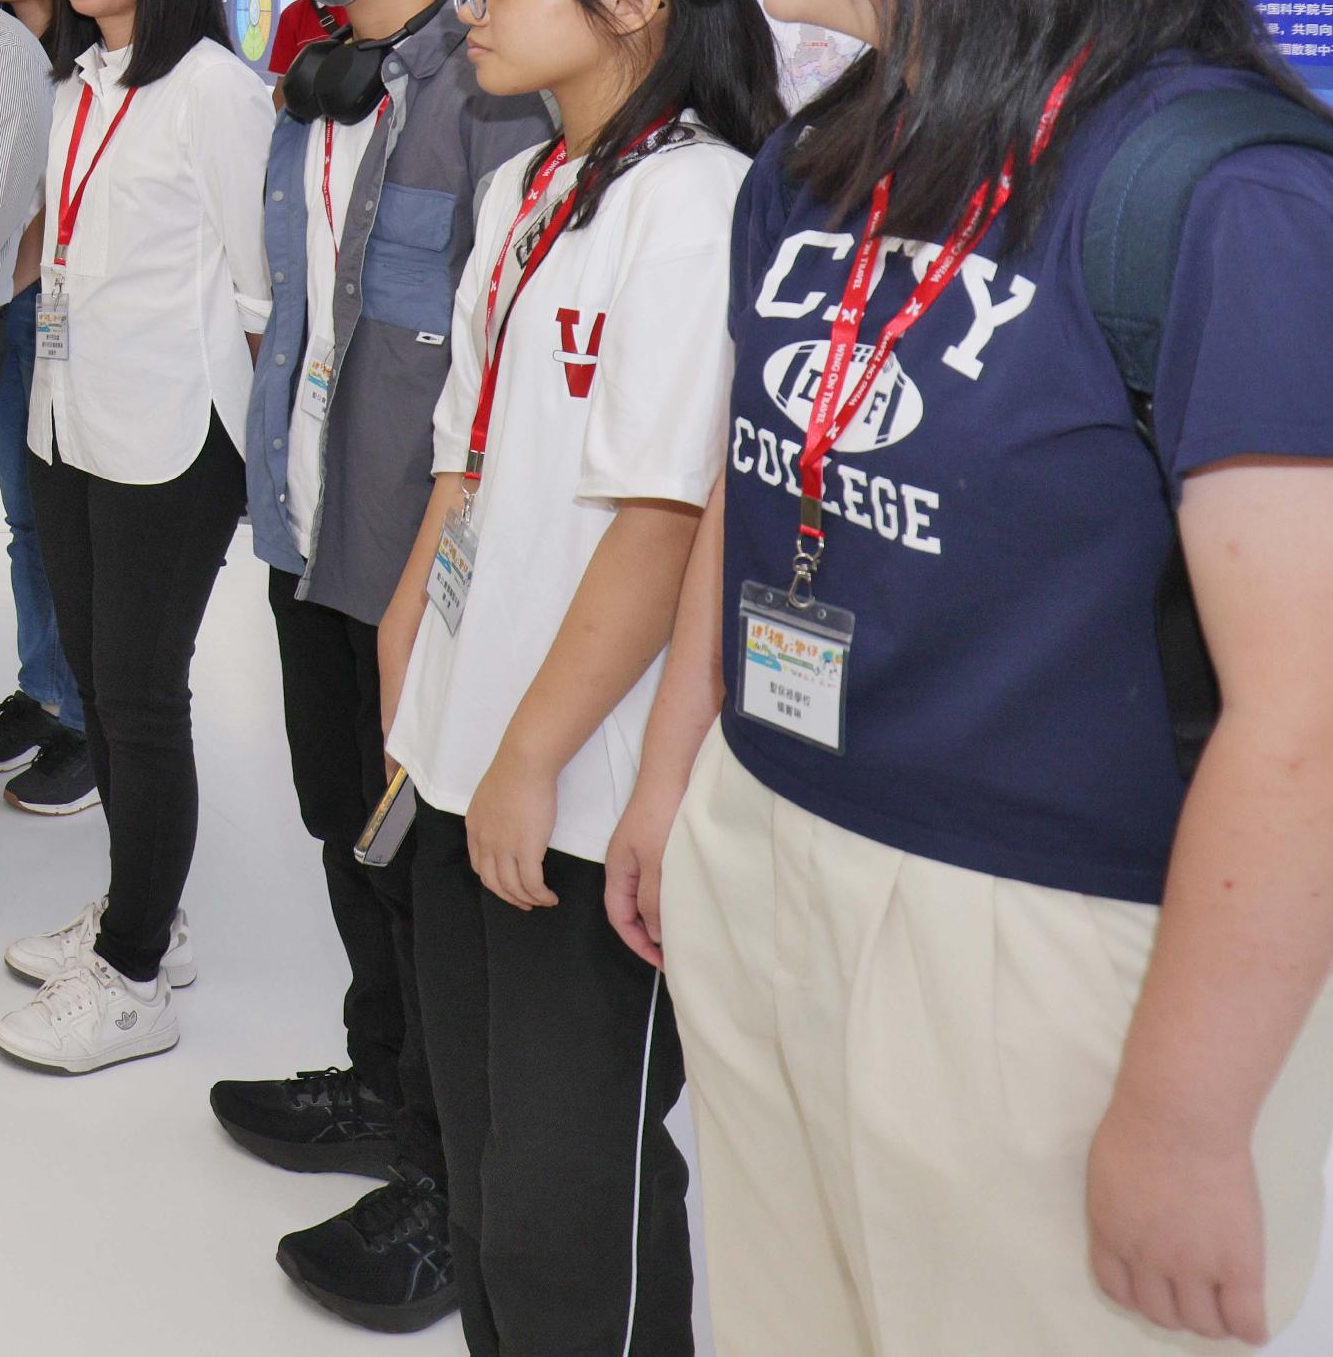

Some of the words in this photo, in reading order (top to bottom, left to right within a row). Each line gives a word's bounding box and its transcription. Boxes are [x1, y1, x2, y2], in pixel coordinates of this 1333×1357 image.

[852, 255, 870, 290] TRAVEL
[930, 254, 955, 283] WING
[832, 343, 848, 375] WING
[848, 379, 869, 407] WING
[865, 363, 878, 382] ON
[874, 330, 894, 364] TRAVEL
[827, 373, 839, 392] ON
[815, 390, 834, 425] TRAVEL
